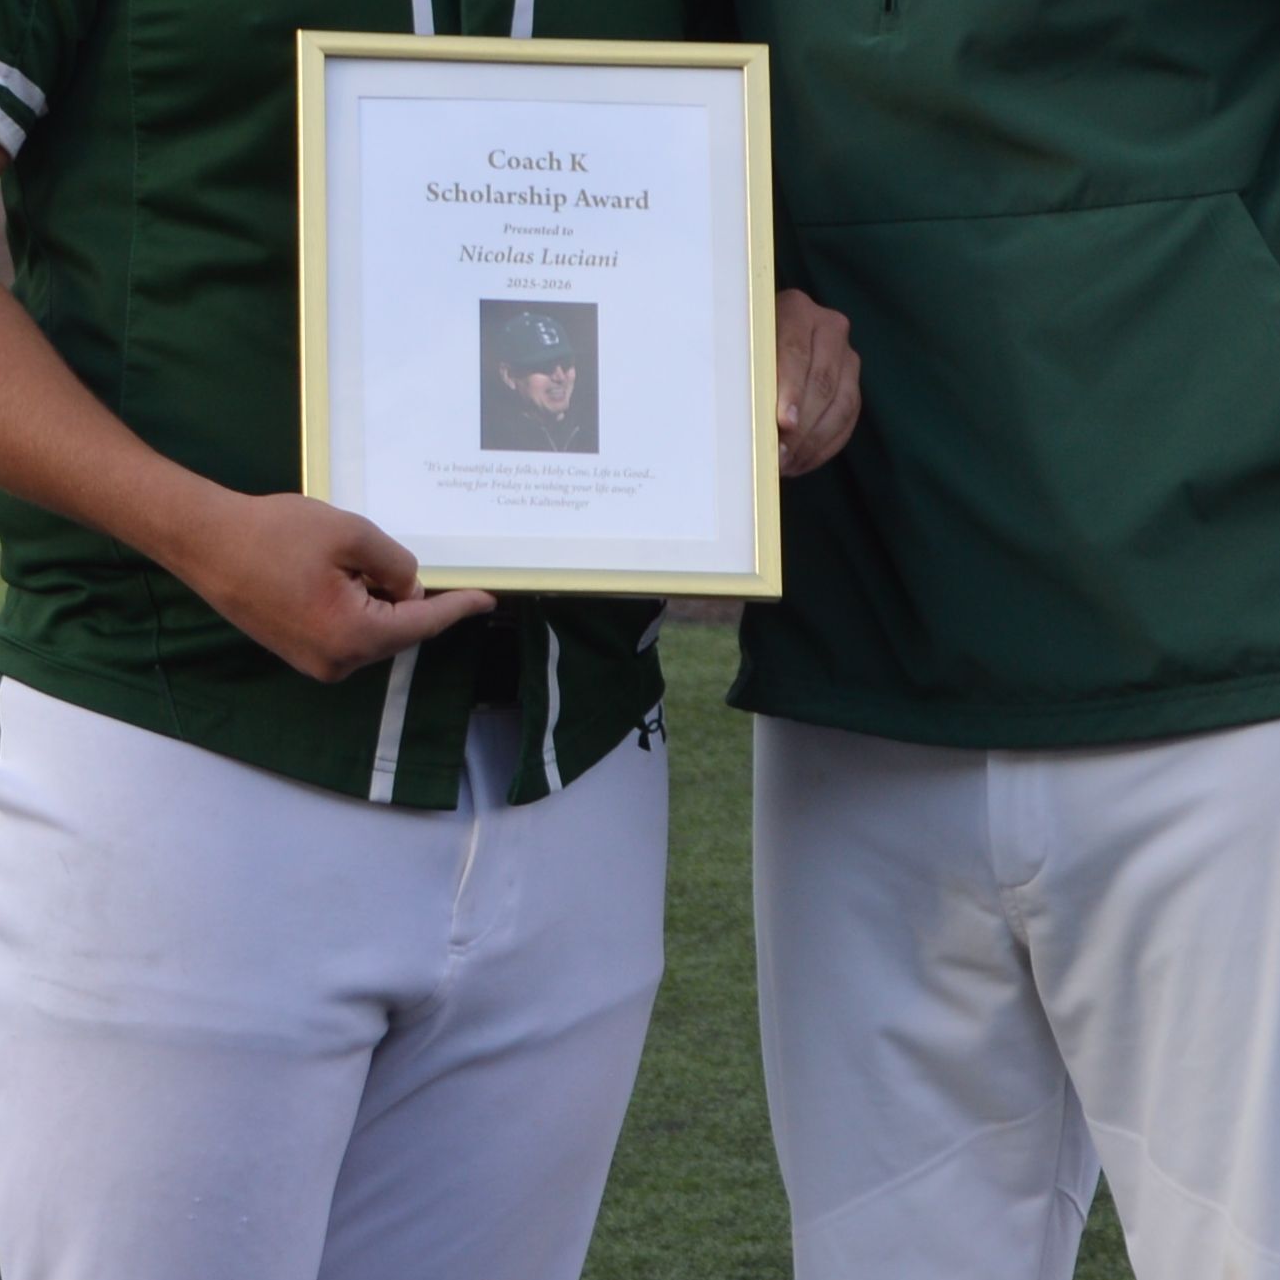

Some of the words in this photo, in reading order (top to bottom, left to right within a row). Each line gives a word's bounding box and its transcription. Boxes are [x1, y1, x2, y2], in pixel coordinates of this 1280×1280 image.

[487, 149, 562, 172] Coach
[569, 152, 589, 172] K
[425, 181, 568, 213] Scholarship
[574, 188, 650, 210] Award
[503, 223, 559, 236] Presented
[562, 225, 574, 237] to
[458, 244, 534, 265] Nicolas
[540, 248, 618, 268] Luciani
[506, 277, 572, 291] 2025-2026
[452, 461, 494, 475] beautiful
[495, 463, 513, 476] day
[490, 479, 521, 493] Friday
[496, 495, 527, 506] Coach
